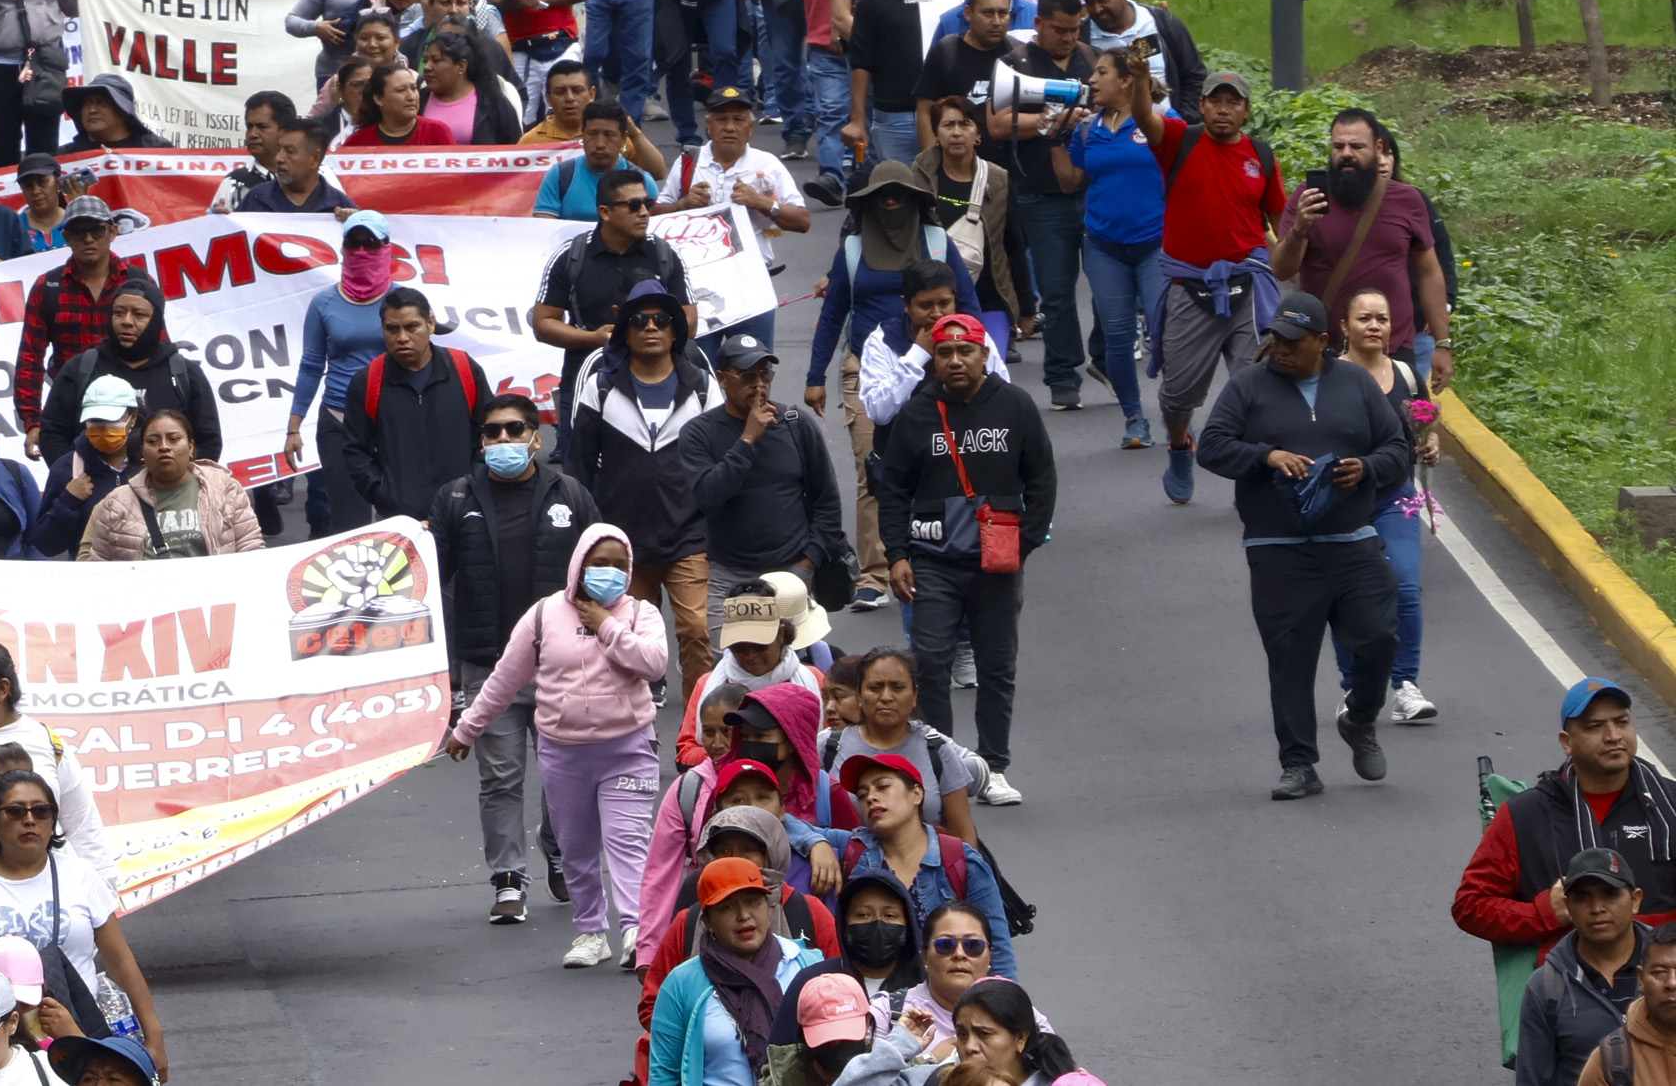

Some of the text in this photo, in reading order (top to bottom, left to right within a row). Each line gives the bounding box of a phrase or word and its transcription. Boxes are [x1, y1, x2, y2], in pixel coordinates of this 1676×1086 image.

[104, 21, 238, 86] VALLE
[164, 105, 181, 124] LEY
[184, 109, 199, 128] DEL
[206, 114, 241, 132] ISSSTE
[932, 428, 1010, 456] BLACK
[98, 602, 237, 683] XIV
[296, 620, 427, 655] ceteg
[20, 680, 234, 709] EMOCRÁTICA
[166, 716, 243, 750] D-I
[258, 712, 295, 738] 4
[311, 684, 443, 735] (403)
[92, 736, 358, 793] UERRERO.
[615, 776, 660, 791] PARIS
